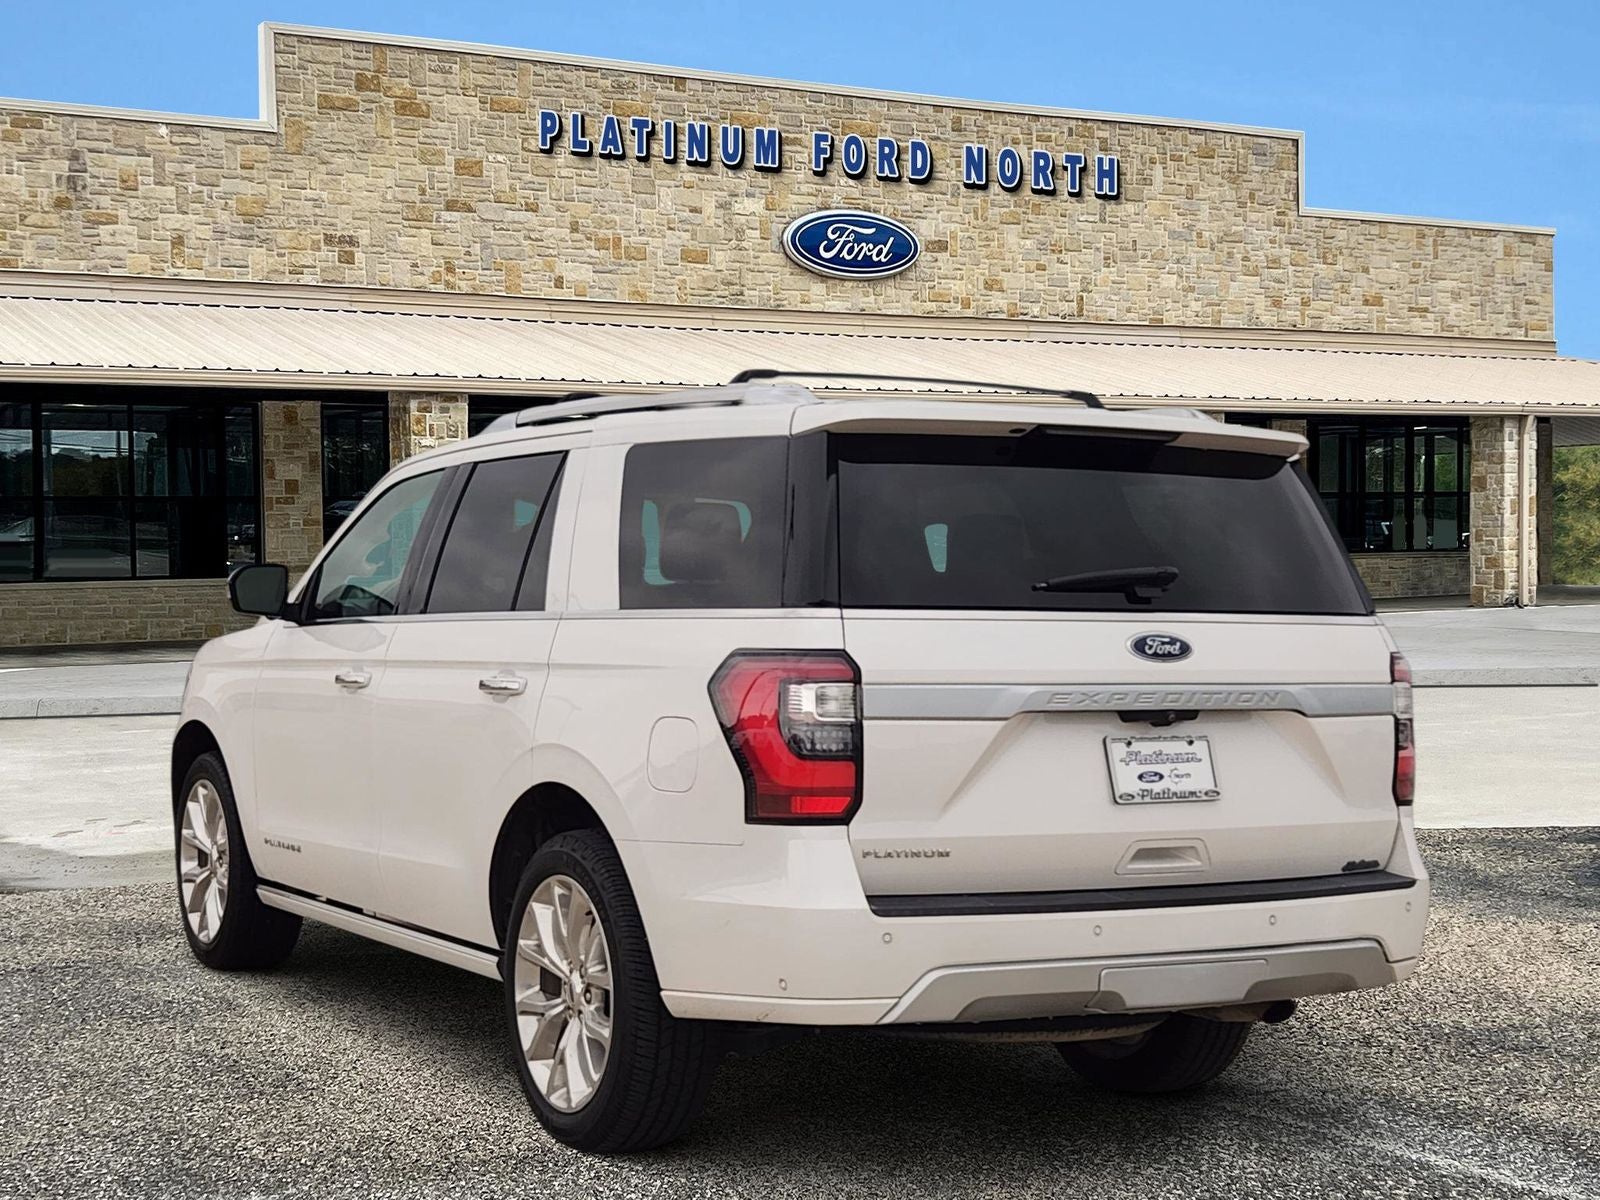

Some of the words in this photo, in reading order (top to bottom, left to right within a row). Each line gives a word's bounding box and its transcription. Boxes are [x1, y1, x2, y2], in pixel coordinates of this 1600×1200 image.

[538, 109, 782, 171] PLATINUM
[812, 131, 933, 183] FORD
[963, 144, 1120, 198] NORTH
[819, 223, 895, 262] Ford
[1144, 636, 1181, 655] Ford
[1048, 691, 1282, 706] EXPEDITION
[1120, 749, 1203, 766] Platinum
[1138, 787, 1203, 801] Platinum
[862, 848, 952, 859] PLATINUM
